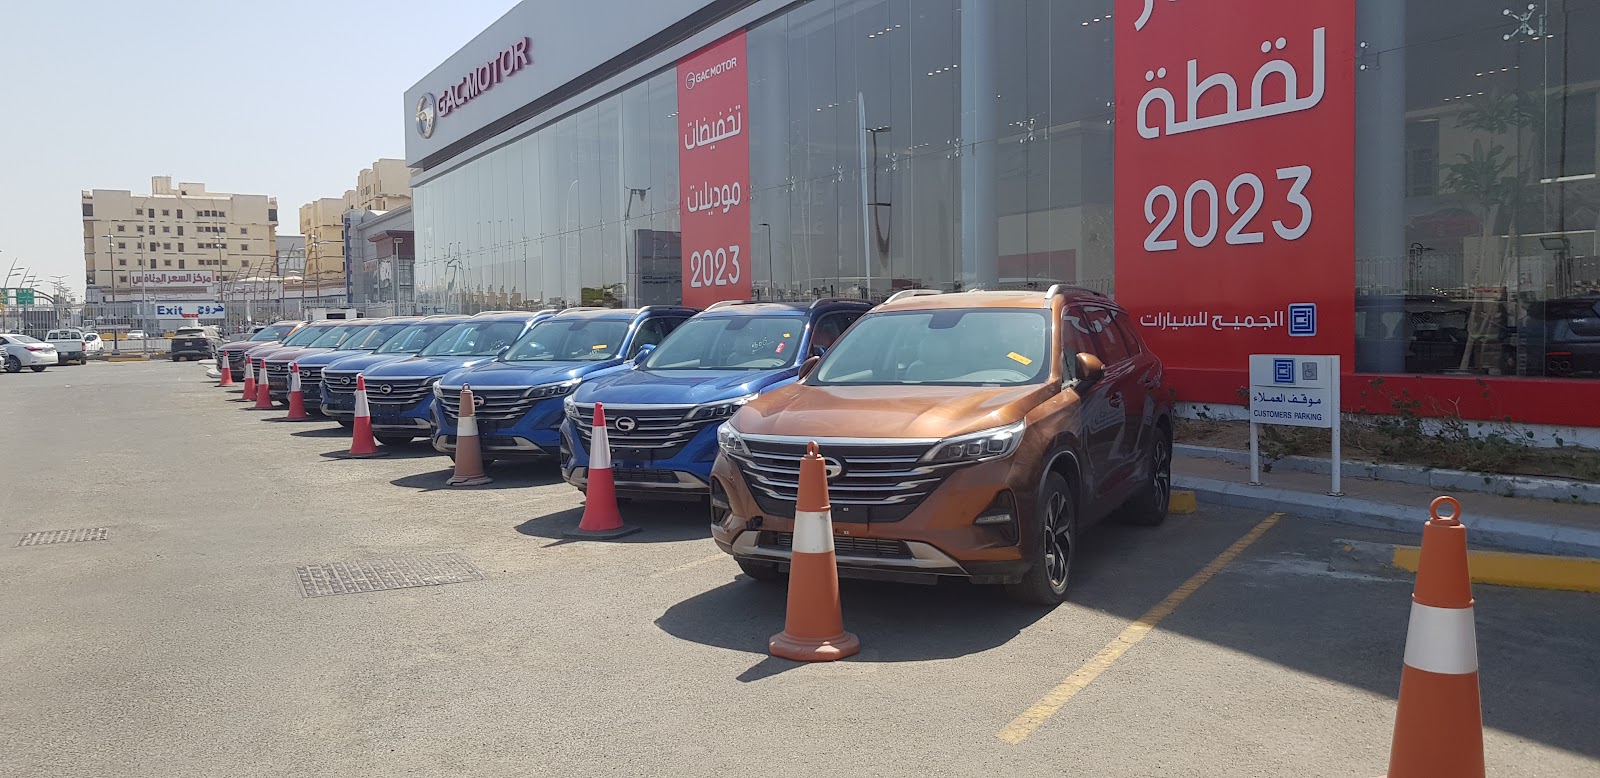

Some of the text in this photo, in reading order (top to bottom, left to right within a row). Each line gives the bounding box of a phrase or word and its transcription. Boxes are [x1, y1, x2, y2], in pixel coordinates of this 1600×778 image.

[437, 36, 531, 117] GAC MOTOR
[695, 57, 738, 84] GAC MOTOR
[1136, 26, 1326, 140] لقطة
[684, 104, 742, 151] تخفيضات
[687, 181, 741, 216] موديلات
[1143, 165, 1313, 252] 2023
[167, 273, 192, 284] السعر
[192, 273, 212, 284] مركز
[690, 245, 741, 288] 2023
[157, 305, 183, 316] Exit
[197, 303, 225, 315] خروج
[1139, 310, 1284, 331] الجميح للسيارات
[1253, 392, 1322, 408] موقف العملاء
[1253, 409, 1322, 421] CUSTOMERS PARKING
